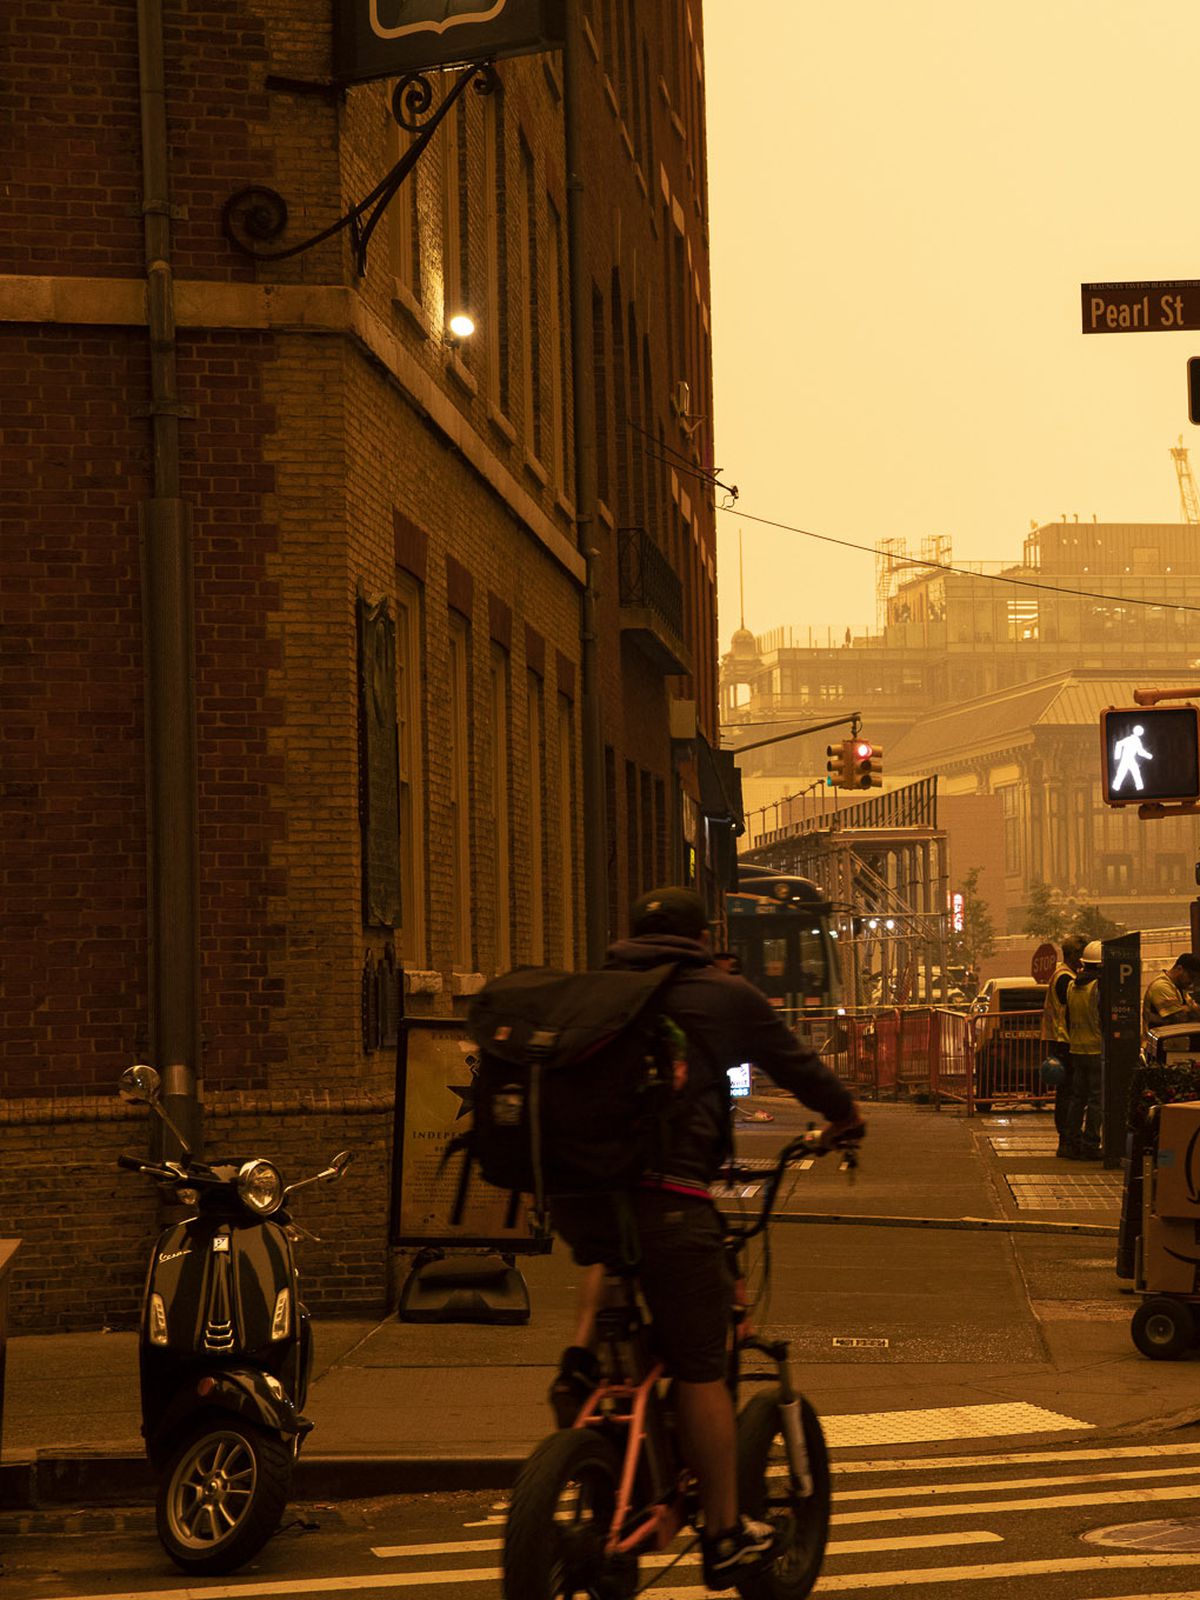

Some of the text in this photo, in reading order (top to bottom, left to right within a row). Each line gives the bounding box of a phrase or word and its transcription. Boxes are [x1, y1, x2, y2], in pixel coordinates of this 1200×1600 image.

[1091, 295, 1185, 328] Pearl St
[1033, 954, 1056, 974] STOP
[1120, 964, 1133, 985] P
